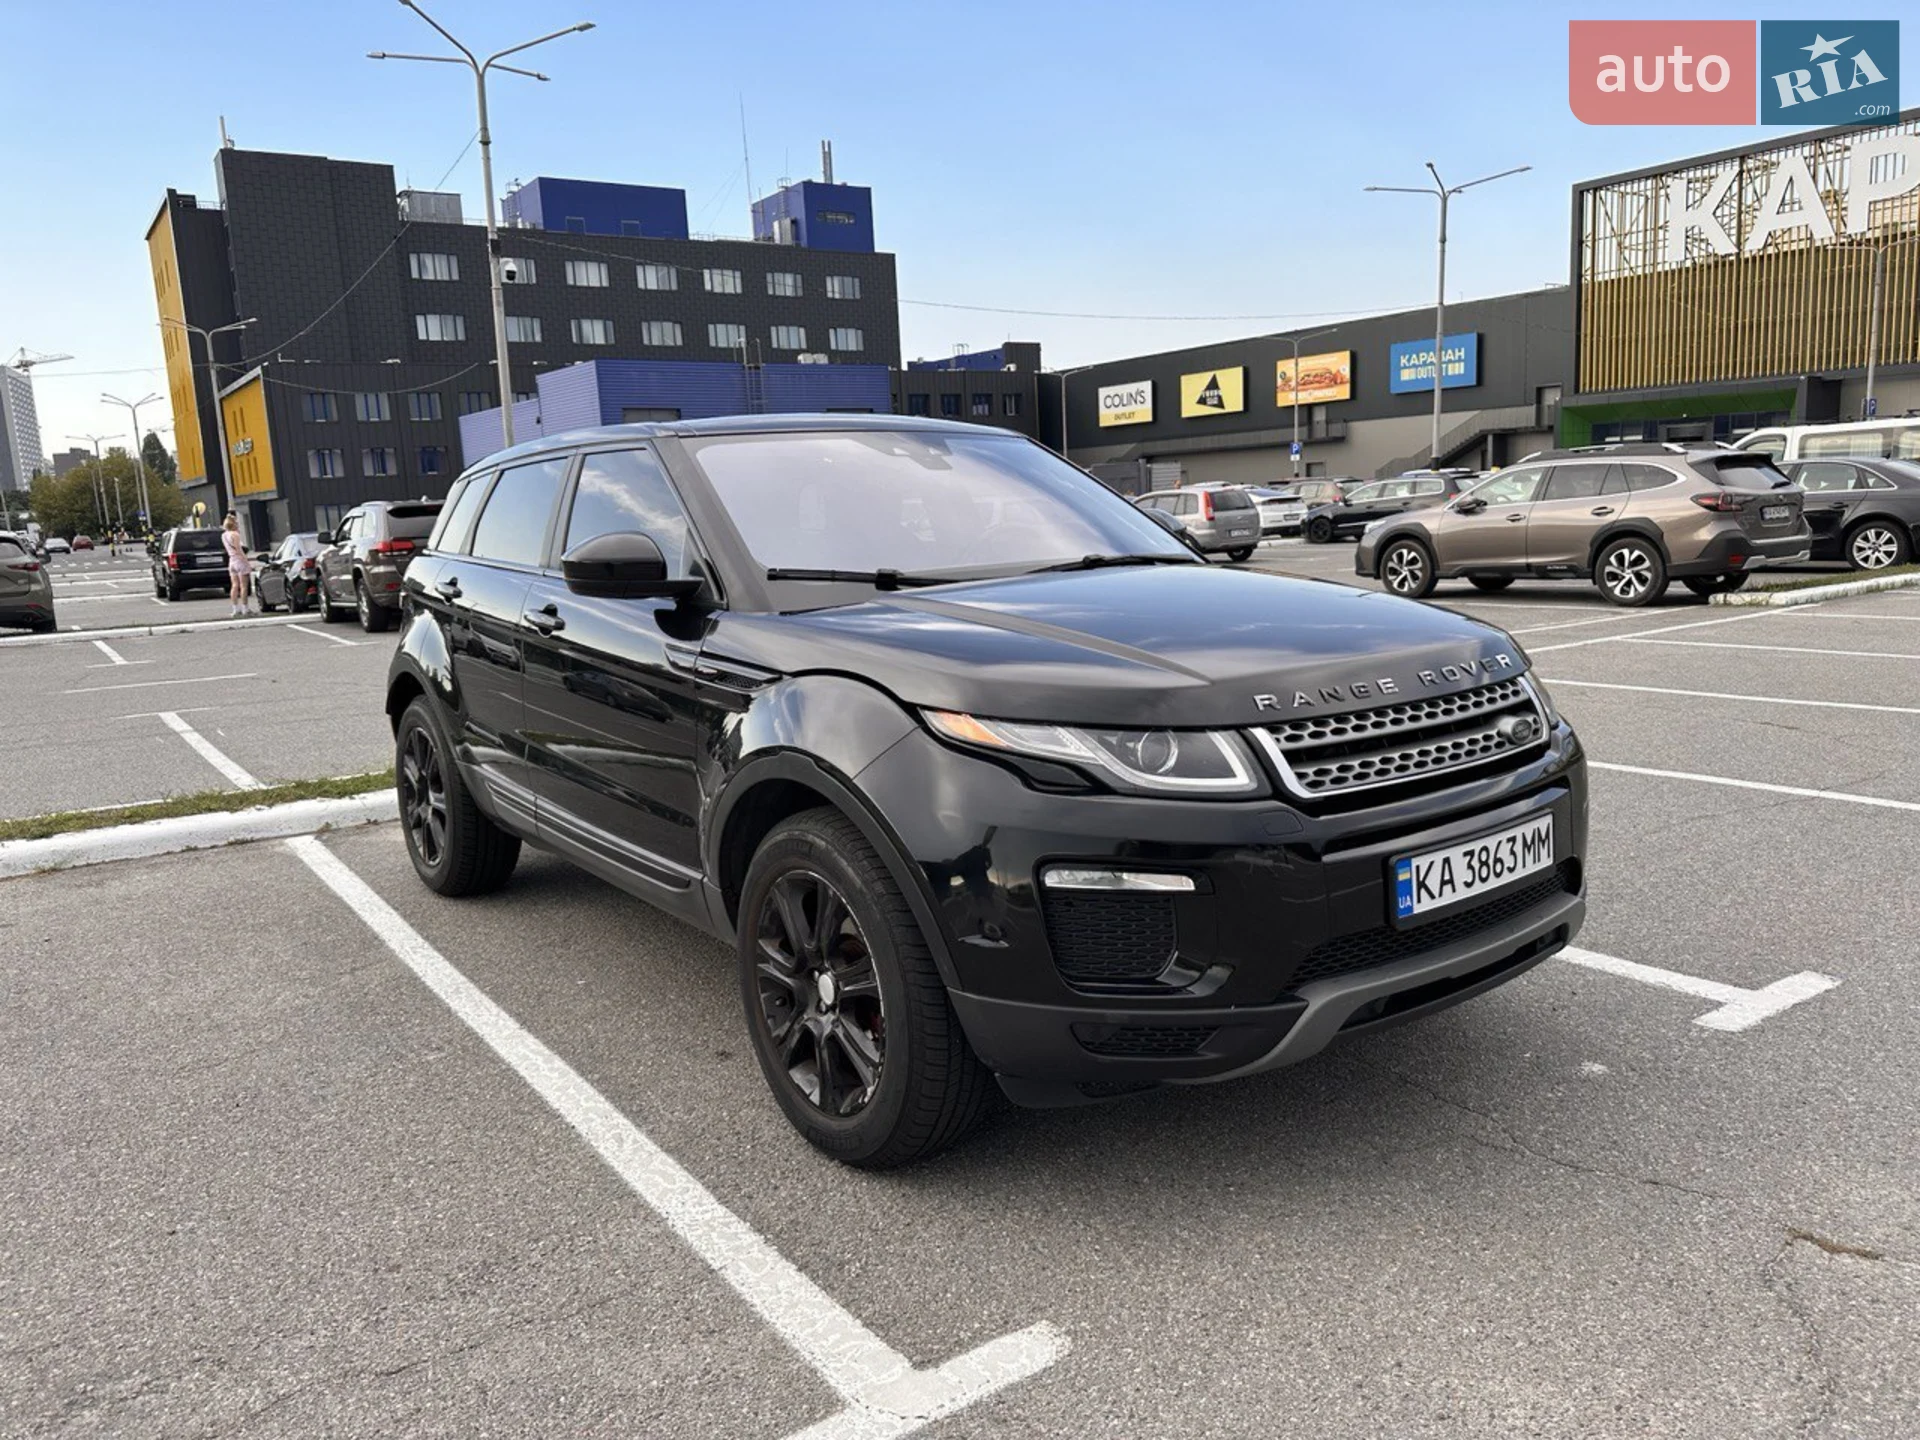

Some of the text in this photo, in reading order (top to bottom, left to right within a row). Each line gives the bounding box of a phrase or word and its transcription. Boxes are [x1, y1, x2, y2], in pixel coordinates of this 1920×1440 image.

[1417, 363, 1447, 379] OUTLT
[1103, 388, 1146, 409] COLIN'S
[1253, 653, 1512, 712] RANGE ROVER
[1399, 896, 1412, 909] UA
